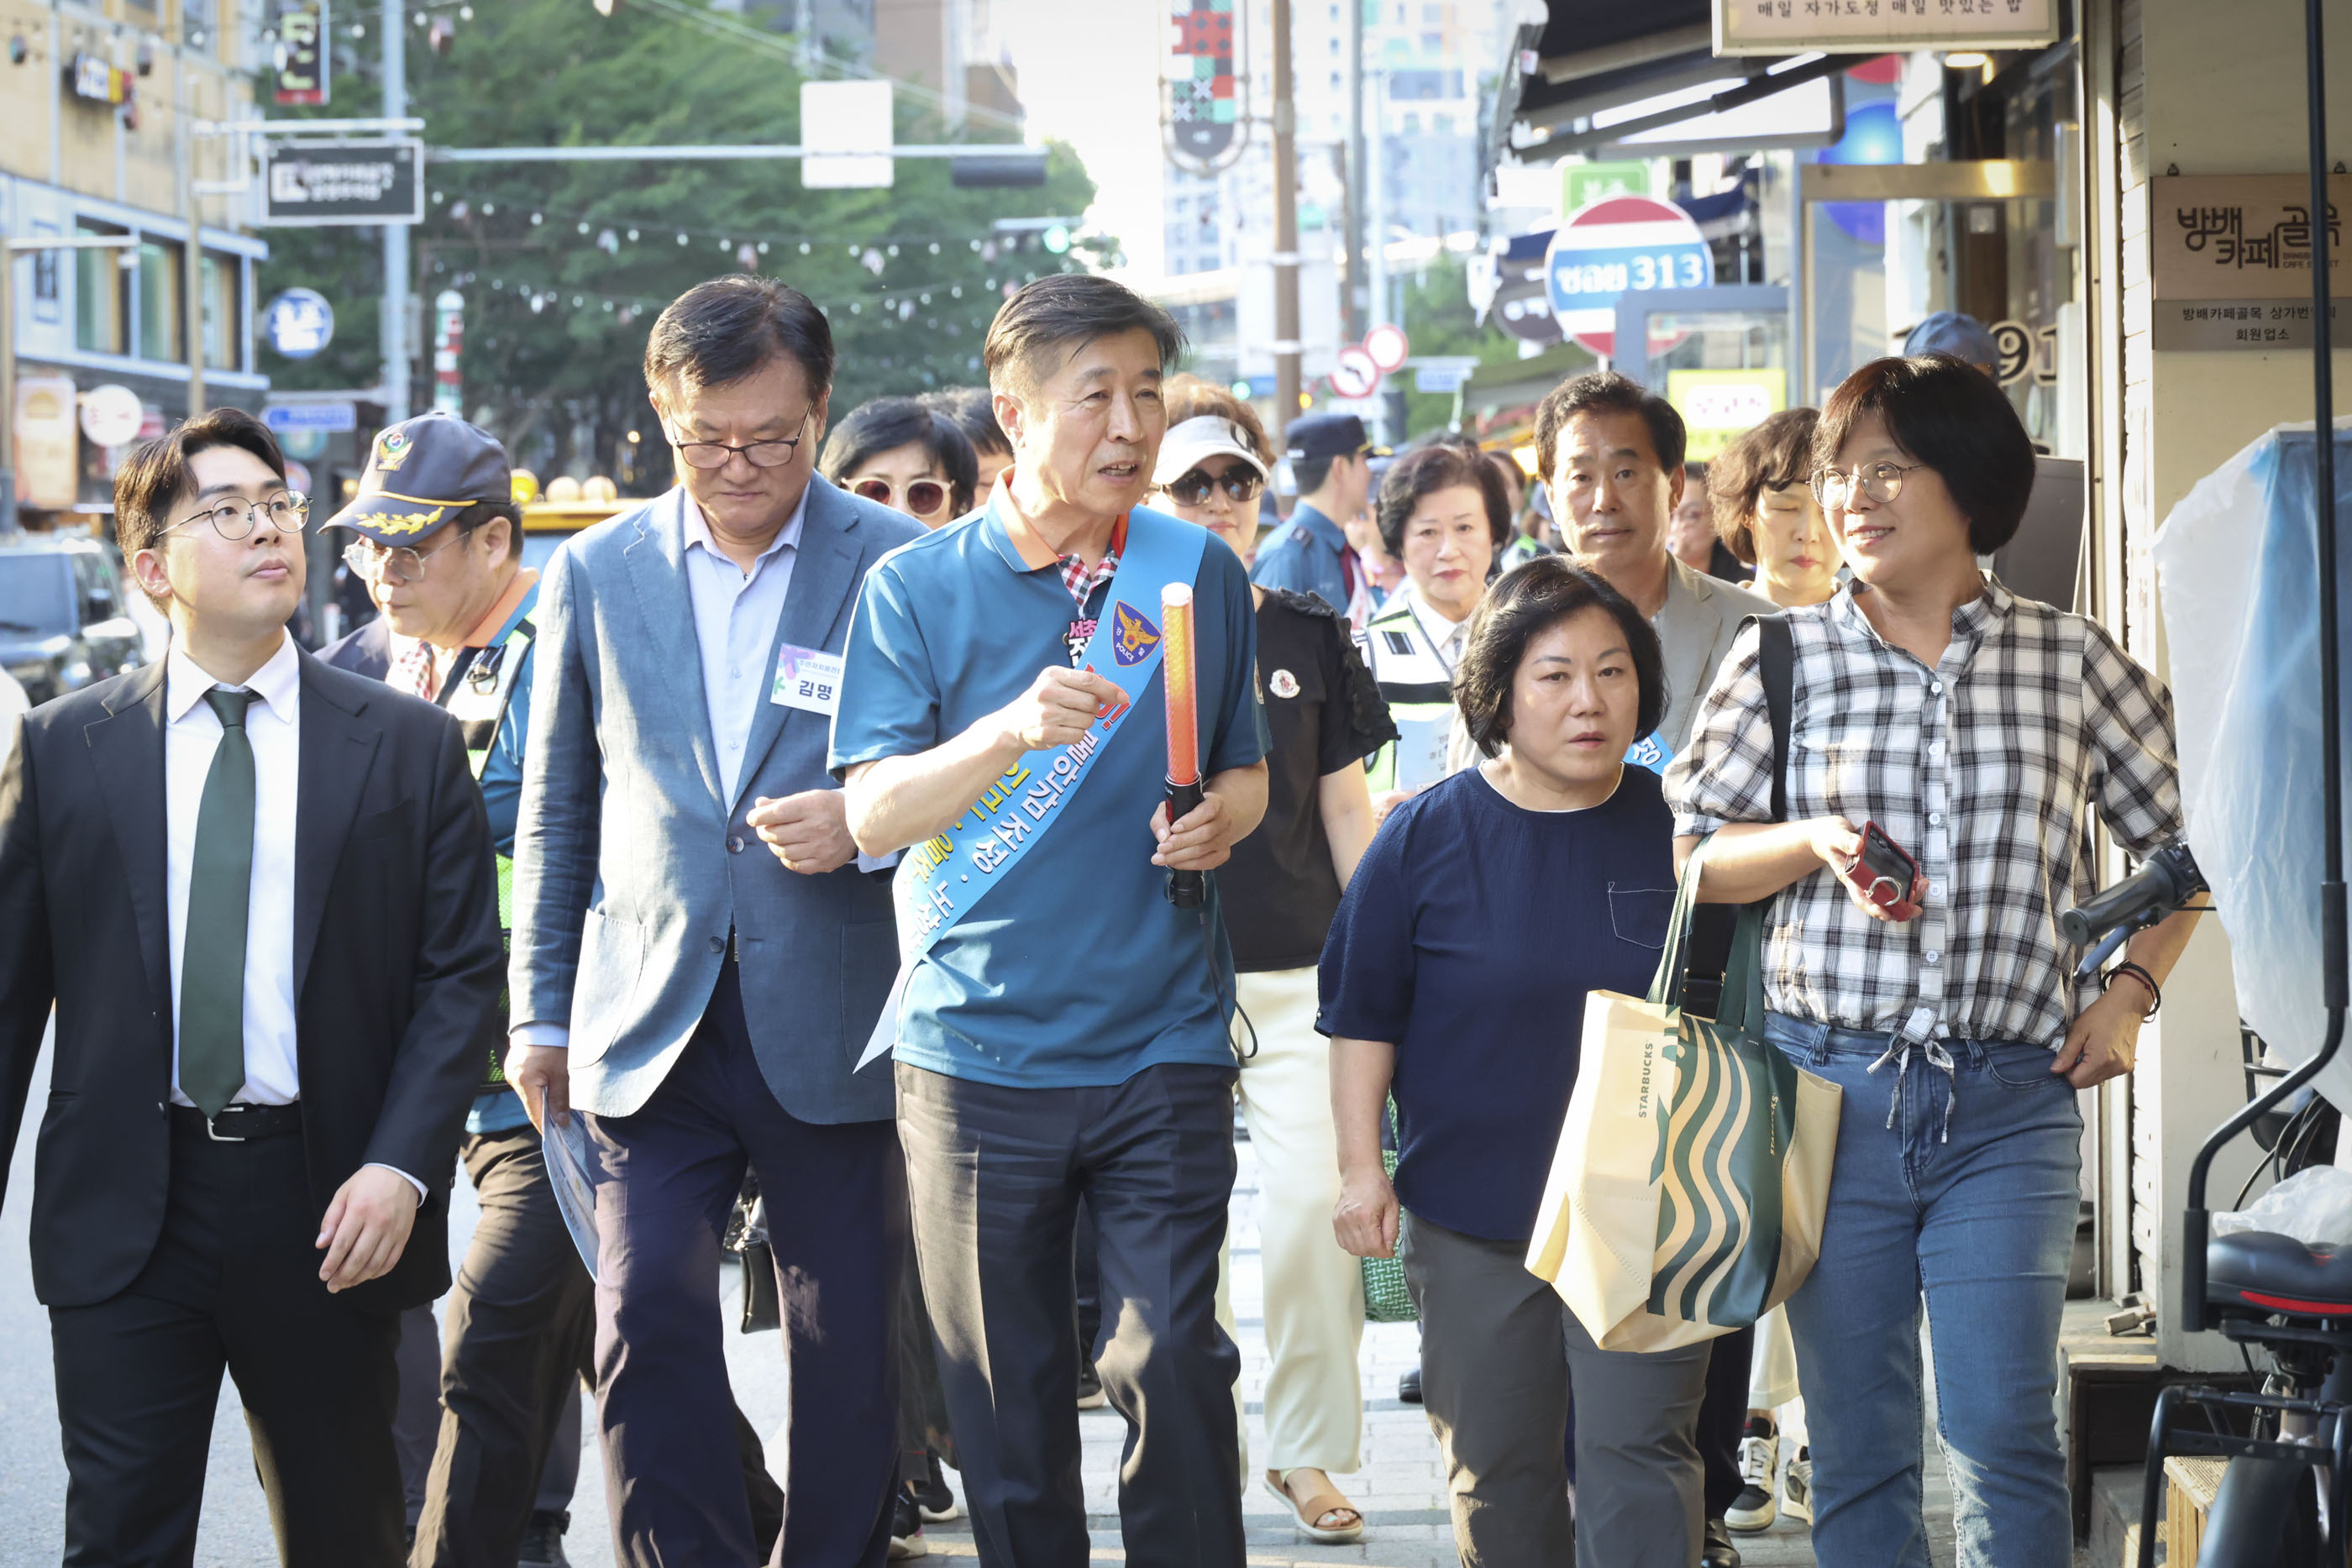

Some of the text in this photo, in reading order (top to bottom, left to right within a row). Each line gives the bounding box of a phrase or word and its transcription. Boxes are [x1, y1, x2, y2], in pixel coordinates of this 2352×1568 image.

[1758, 0, 1791, 18] 매일
[1804, 0, 1878, 16] 자가도정
[1892, 0, 1925, 15] 매일
[1940, 0, 1994, 14] 맛있는
[2176, 207, 2243, 252] 방배
[2215, 233, 2280, 269] 카페
[1630, 253, 1704, 291] 313
[2282, 260, 2304, 269] CAFE
[2182, 306, 2337, 321] 방배카페골목 상가번
[2235, 328, 2291, 341] 회원업소
[1116, 642, 1135, 663] POLICE
[971, 810, 1032, 874] 조성
[909, 831, 954, 885] 음주
[1638, 1042, 1653, 1118] STARBUCKS
